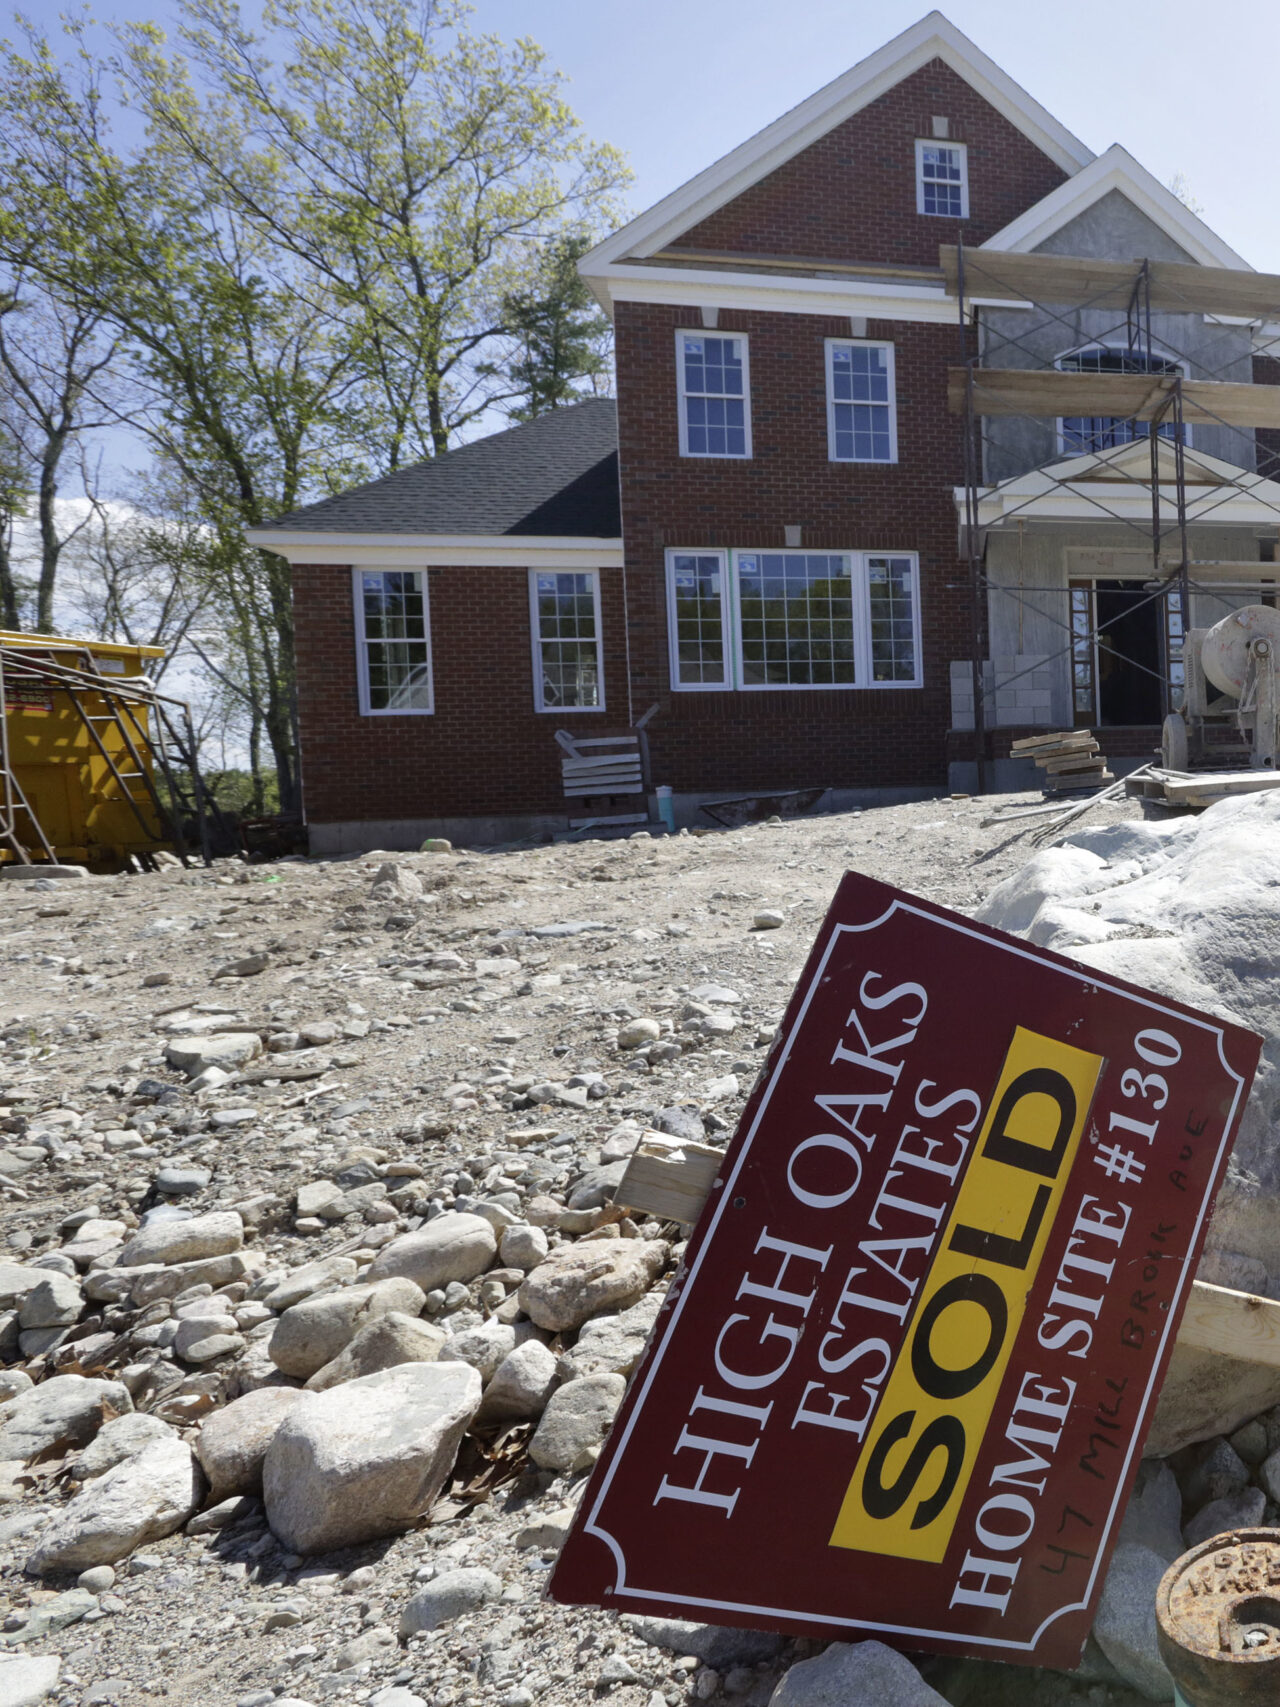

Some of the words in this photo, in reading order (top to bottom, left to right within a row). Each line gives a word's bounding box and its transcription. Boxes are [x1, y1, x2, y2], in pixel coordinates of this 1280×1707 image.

[653, 1226, 833, 1518] HIGH
[788, 970, 927, 1208] OAKS
[791, 1078, 981, 1442] ESTATES
[861, 1067, 1076, 1529] SOLD
[948, 1371, 1076, 1616] HOME
[1037, 1194, 1133, 1359] SITE
[1093, 1028, 1182, 1183] #130
[1039, 1505, 1094, 1574] 47
[1079, 1376, 1127, 1478] MILL
